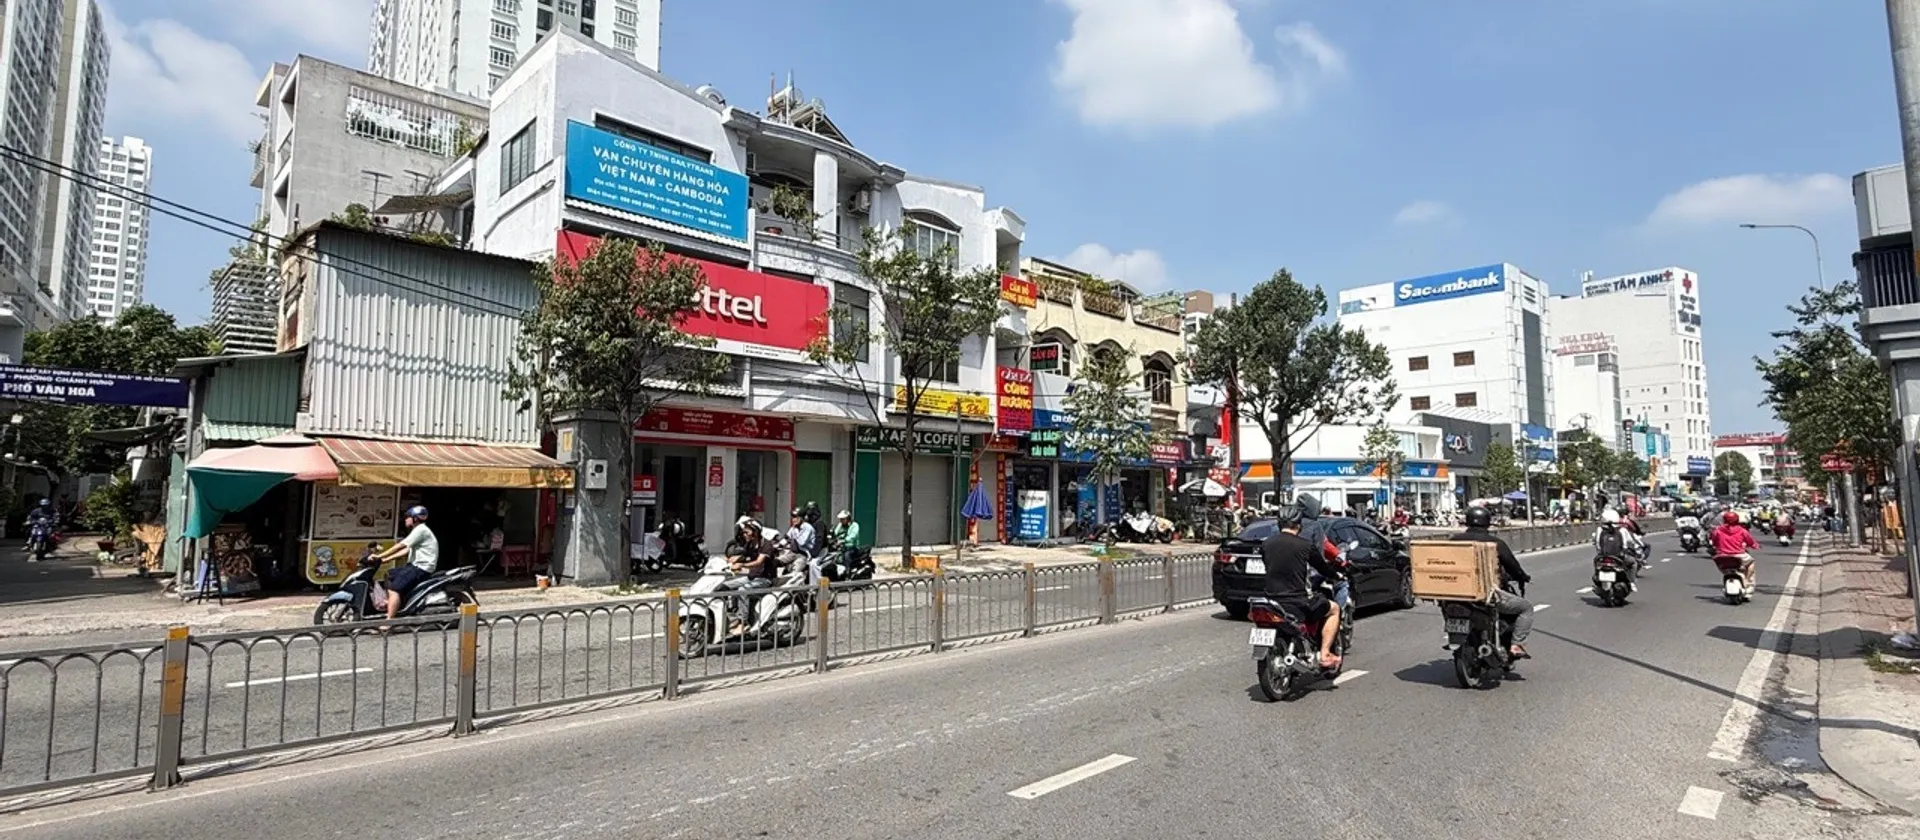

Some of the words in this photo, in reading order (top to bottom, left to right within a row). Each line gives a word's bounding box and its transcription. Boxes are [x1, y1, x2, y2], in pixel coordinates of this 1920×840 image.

[613, 138, 636, 152] CÔNG
[638, 145, 648, 155] TY
[593, 146, 619, 162] VẬN
[673, 170, 705, 188] HÀNG
[598, 162, 627, 178] VIỆT
[630, 171, 656, 187] NAM
[665, 181, 724, 207] CAMBODIA
[1399, 272, 1500, 300] Sacombank
[1613, 276, 1637, 292] TÂM
[1639, 273, 1663, 287] ANH
[691, 285, 767, 323] ttel
[3, 381, 33, 394] PHỐ
[880, 428, 921, 443] KAFN
